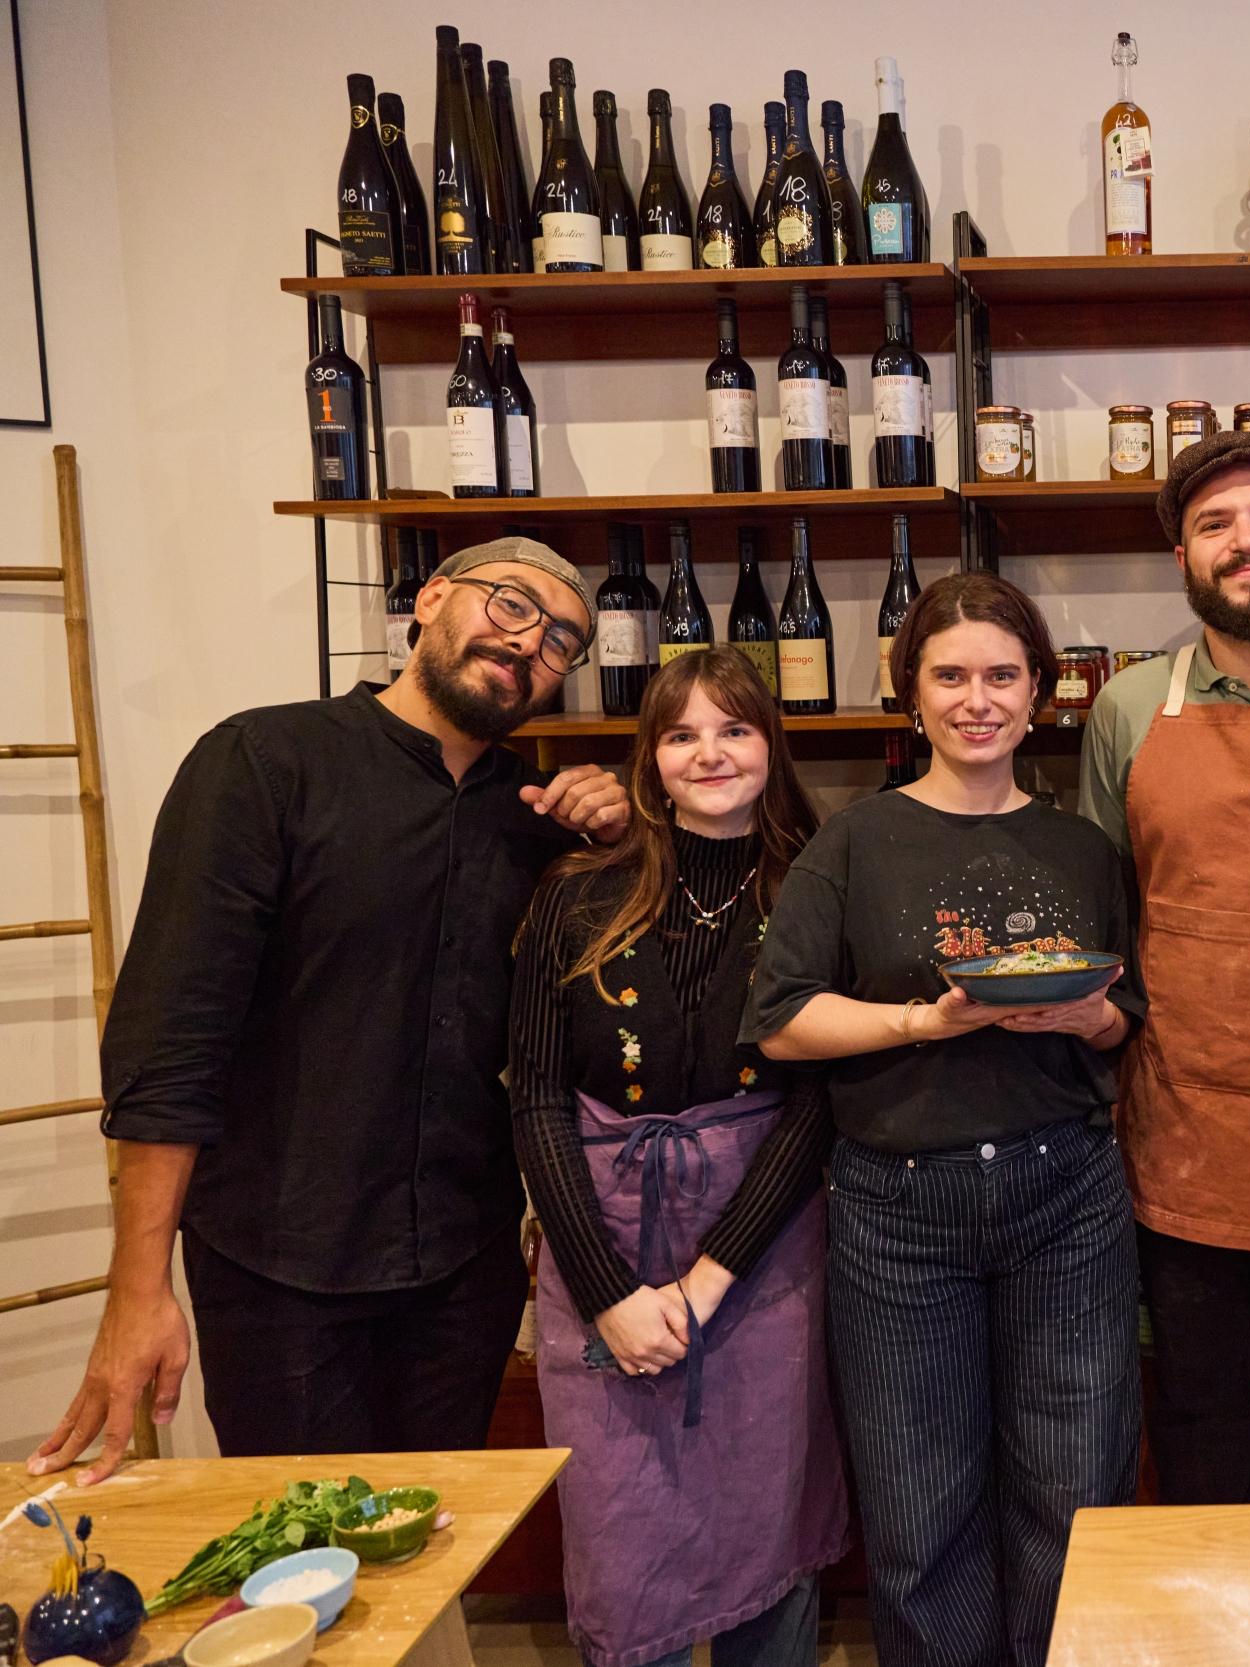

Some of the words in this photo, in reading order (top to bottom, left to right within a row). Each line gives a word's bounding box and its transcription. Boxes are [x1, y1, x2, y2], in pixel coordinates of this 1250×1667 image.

[438, 168, 457, 187] 24
[342, 188, 358, 202] 18
[780, 175, 806, 202] 18
[705, 204, 722, 223] 18
[551, 226, 585, 239] Rustico
[315, 368, 337, 381] 30
[674, 617, 689, 636] 19
[1063, 714, 1071, 724] 6
